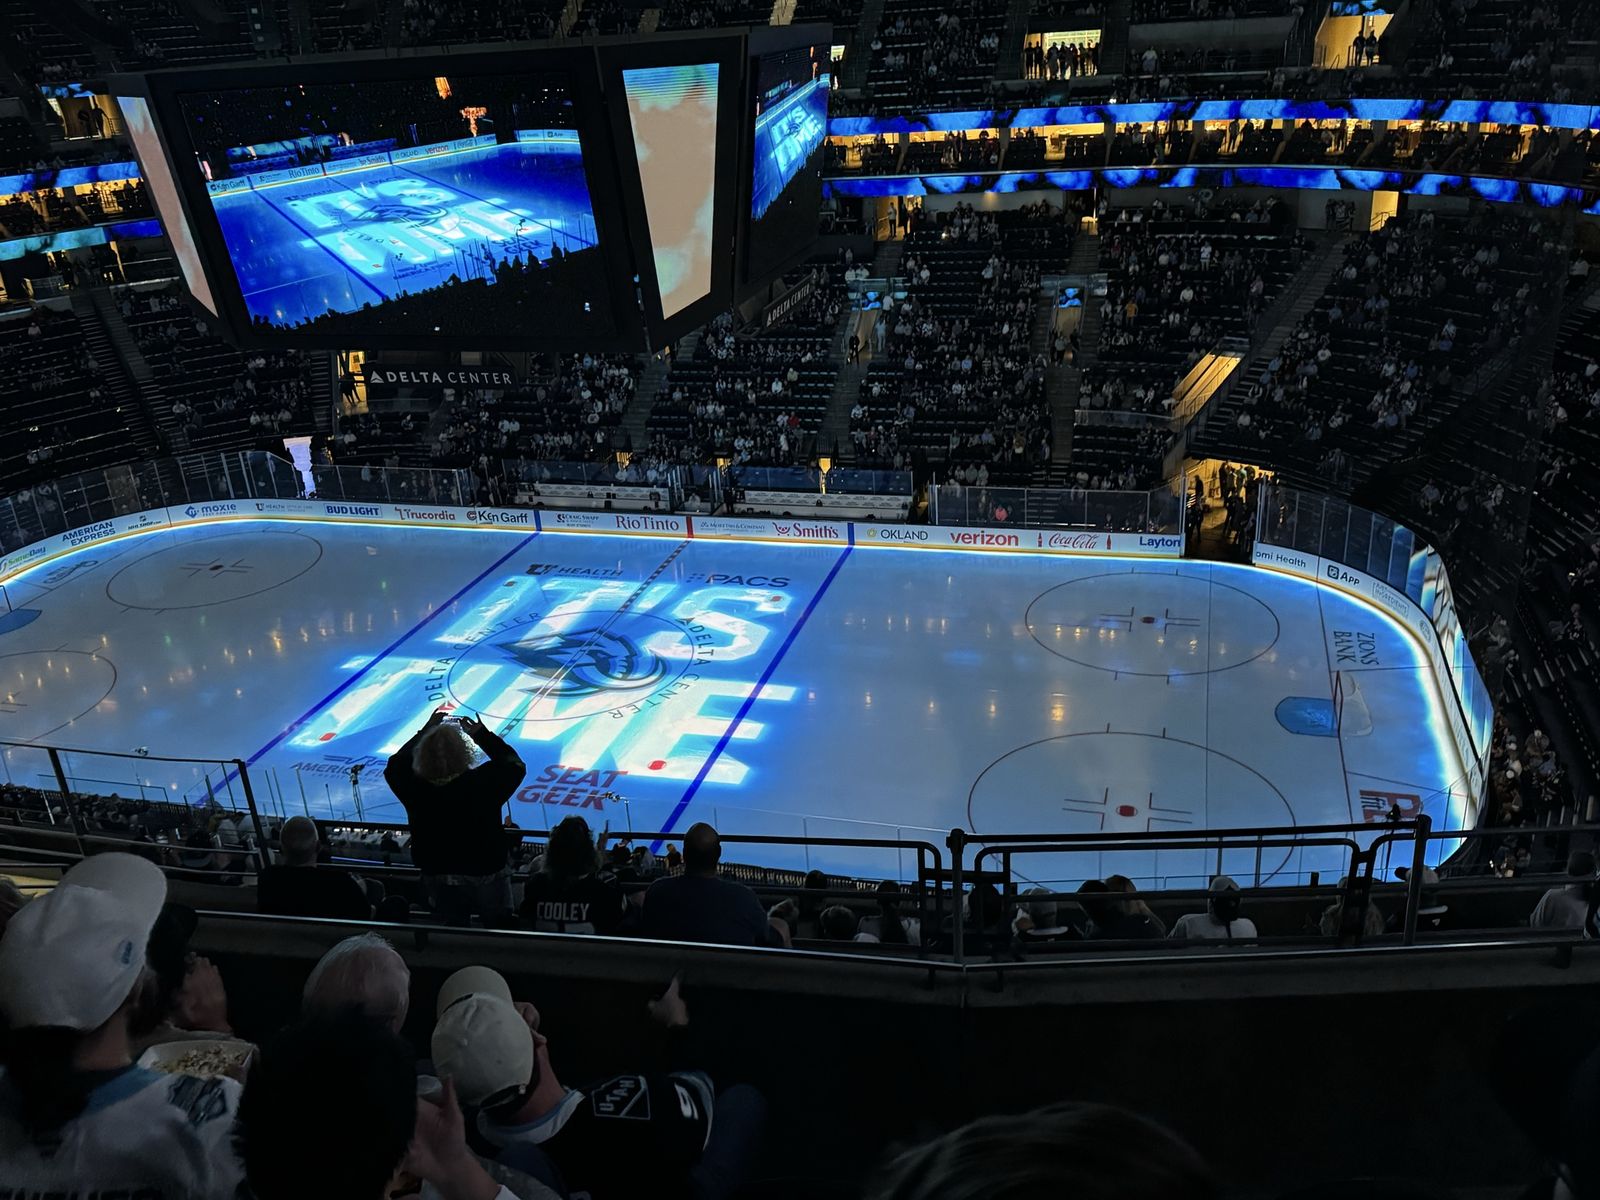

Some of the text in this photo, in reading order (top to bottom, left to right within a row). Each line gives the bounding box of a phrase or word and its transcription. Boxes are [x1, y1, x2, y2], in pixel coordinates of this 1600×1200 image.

[772, 283, 810, 321] DELTA CENTER
[386, 371, 512, 385] DELTA CENTER
[201, 503, 237, 513] moxie
[326, 505, 379, 516] BUD LIGHT
[404, 508, 456, 521] Trucordia
[478, 510, 528, 524] Ken Garff
[62, 520, 113, 542] AMERICAN
[71, 528, 116, 547] EXPRESS
[793, 522, 839, 539] Smith's
[880, 528, 929, 541] OKLAND
[950, 530, 1019, 546] verizon
[1139, 535, 1181, 548] Layton
[7, 545, 46, 566] SameDay
[1276, 553, 1306, 568] Health
[558, 566, 624, 576] HEALTH
[705, 573, 791, 588] PACS
[434, 575, 795, 662] IT'S
[425, 611, 541, 702] DELTA CENTER
[1333, 630, 1357, 664] BANK
[1356, 631, 1379, 666] ZIONS
[608, 624, 714, 719] DELTA CENTER
[285, 655, 798, 788] TIME
[290, 762, 352, 776] AMERIC
[535, 764, 628, 788] SEAT
[516, 784, 606, 811] GEEK
[536, 901, 590, 921] COOLEY
[599, 1080, 635, 1112] UTAH
